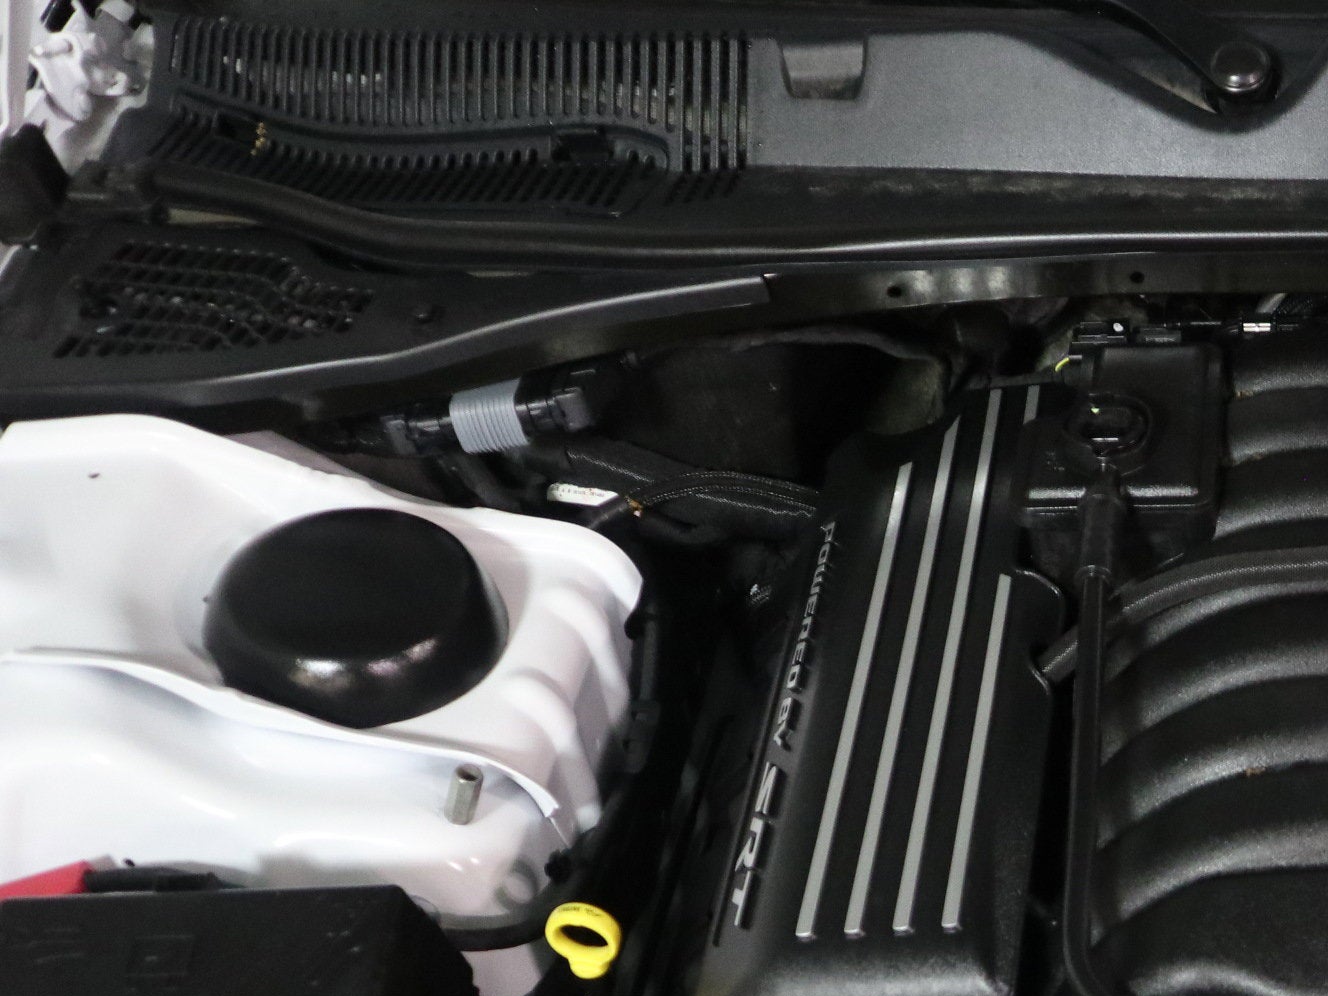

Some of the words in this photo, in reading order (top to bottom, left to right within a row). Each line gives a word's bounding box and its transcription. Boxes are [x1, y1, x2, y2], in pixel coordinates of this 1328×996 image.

[786, 521, 836, 690] POWERED
[773, 696, 796, 748] BY
[731, 760, 780, 928] SRT
